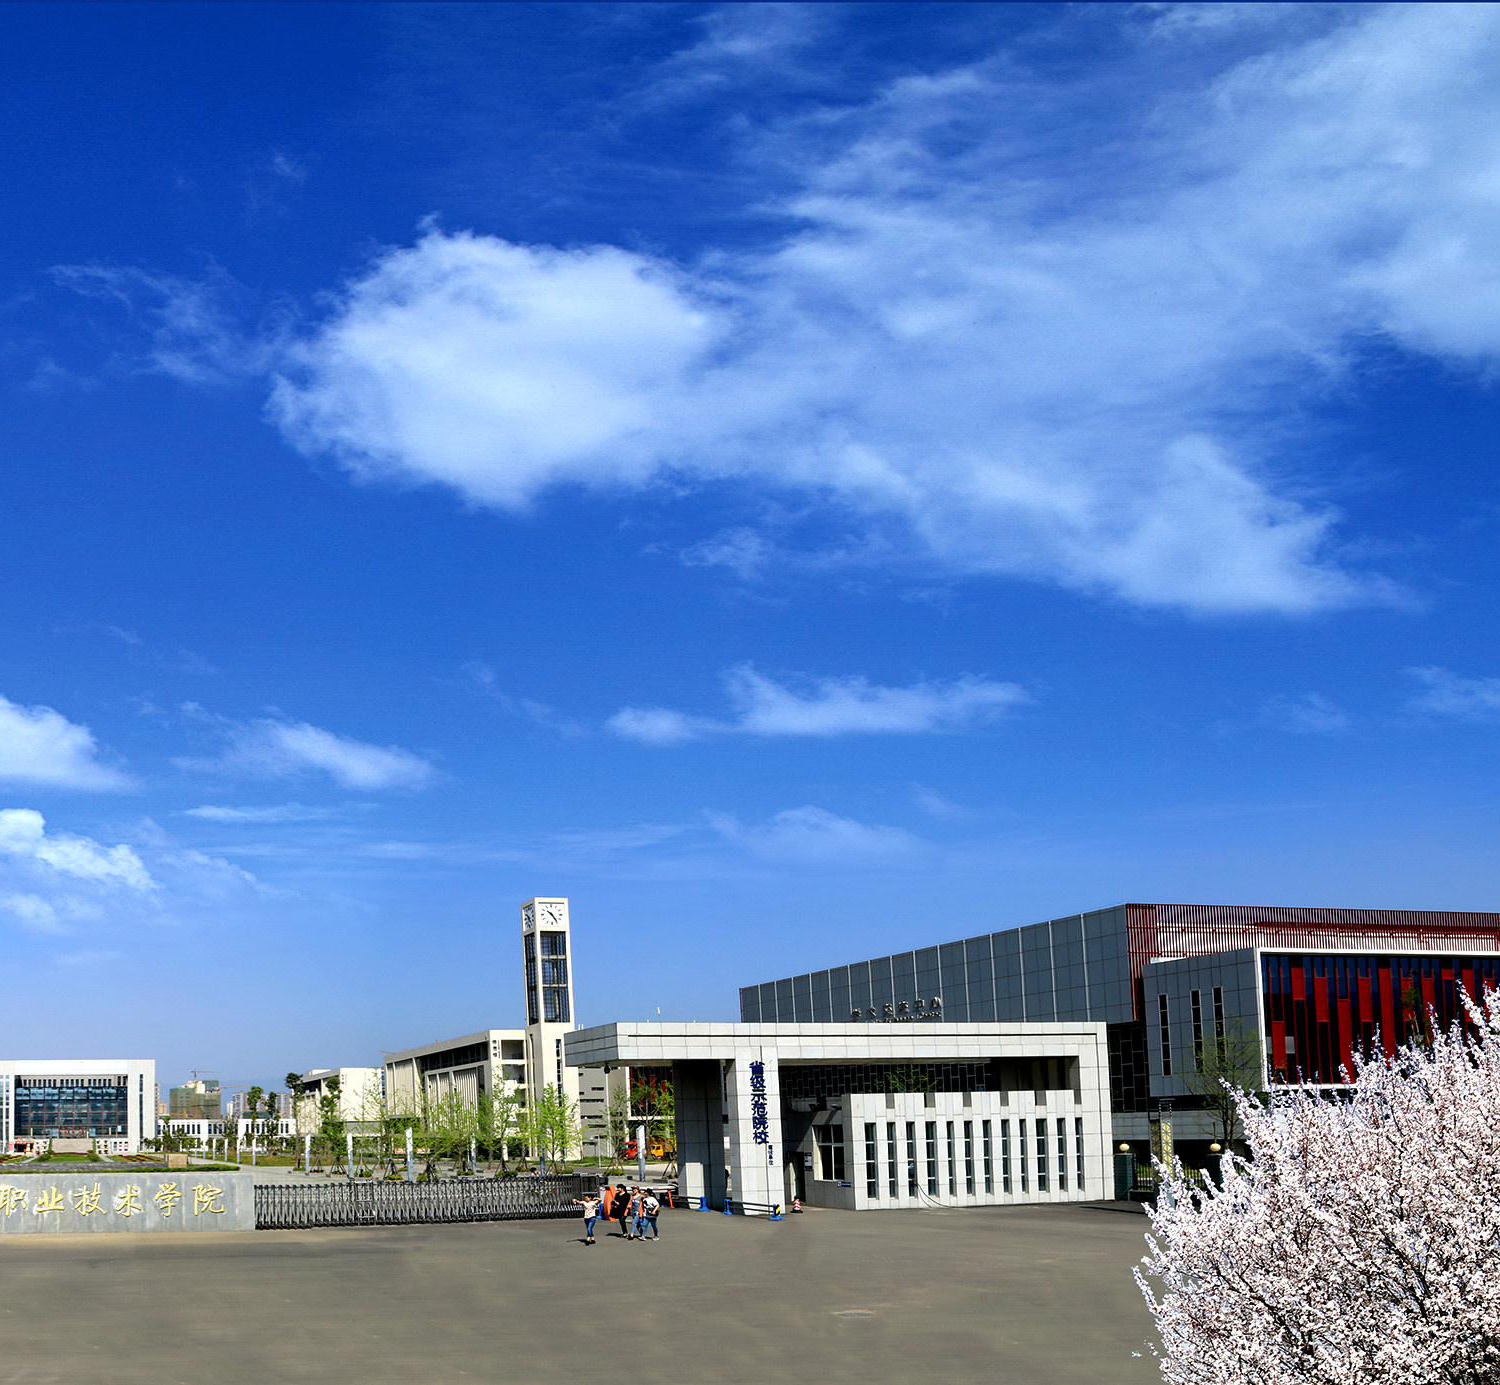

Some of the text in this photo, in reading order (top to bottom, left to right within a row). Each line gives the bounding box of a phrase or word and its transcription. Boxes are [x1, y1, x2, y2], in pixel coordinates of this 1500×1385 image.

[749, 1061, 769, 1145] 省级示范院校
